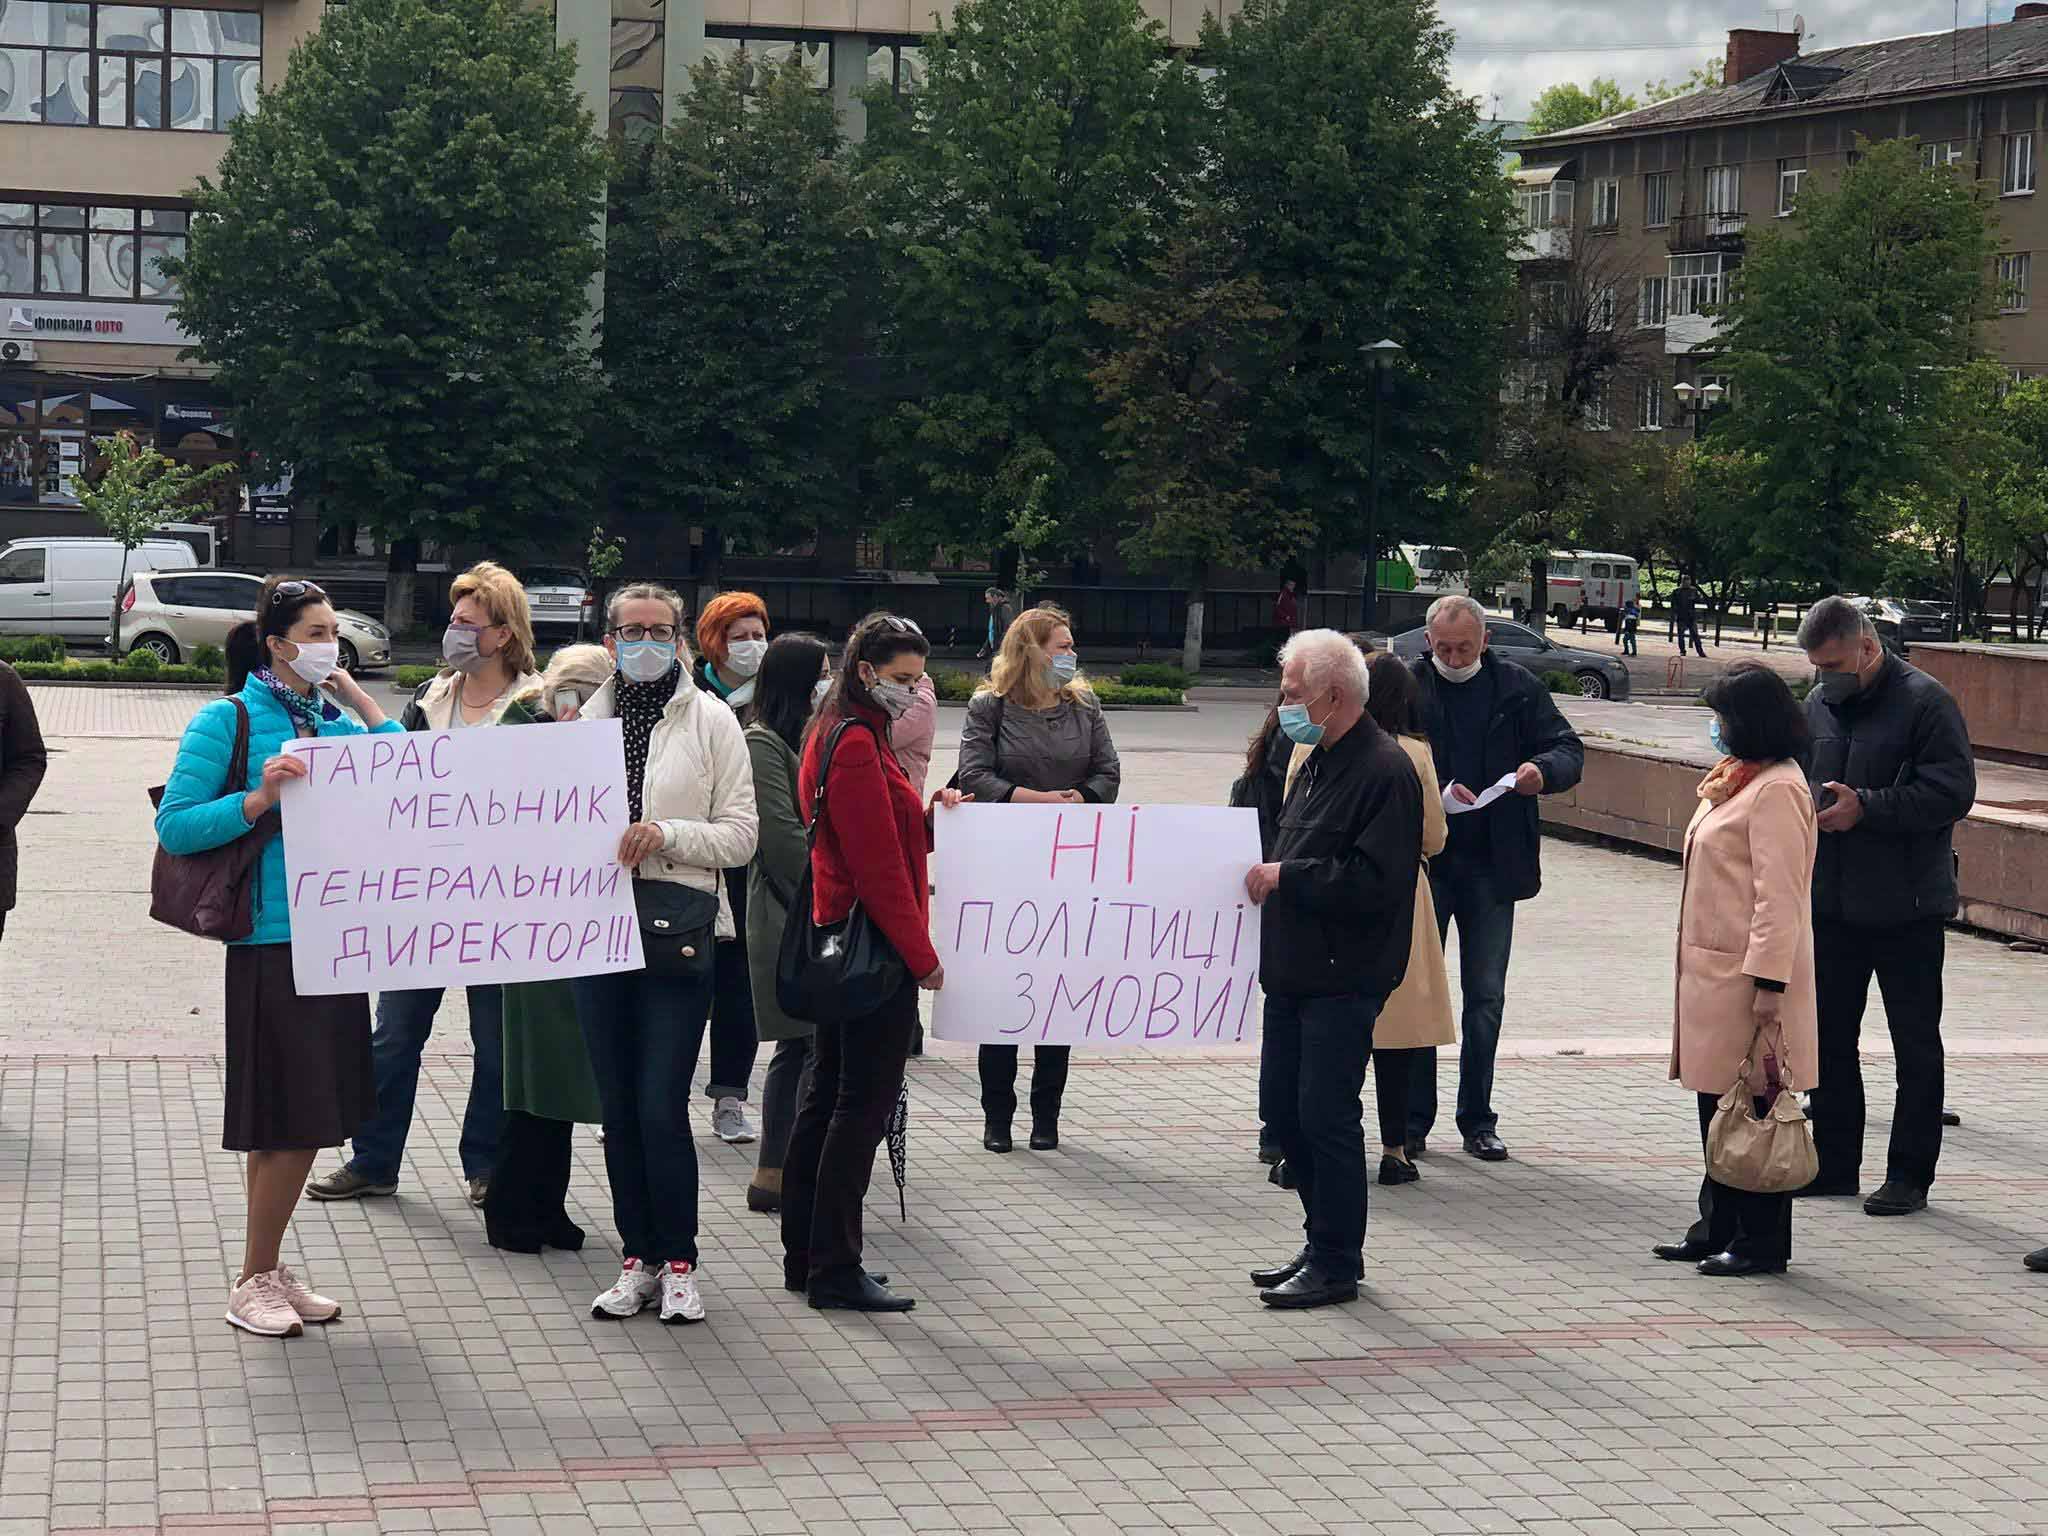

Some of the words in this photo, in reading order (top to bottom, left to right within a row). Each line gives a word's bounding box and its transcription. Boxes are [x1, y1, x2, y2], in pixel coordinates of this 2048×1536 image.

[293, 735, 452, 786] ТАРАС
[388, 785, 612, 830] МЕЛЬНИК
[1050, 805, 1140, 885] НІ
[293, 861, 622, 909] ГЕНЕРАЛЬНИЙ
[333, 914, 633, 978] ДИРЕКТОР!!!
[955, 896, 1245, 970] ПОЛІТИЦІ
[999, 969, 1256, 1043] ЗМОВИ!
